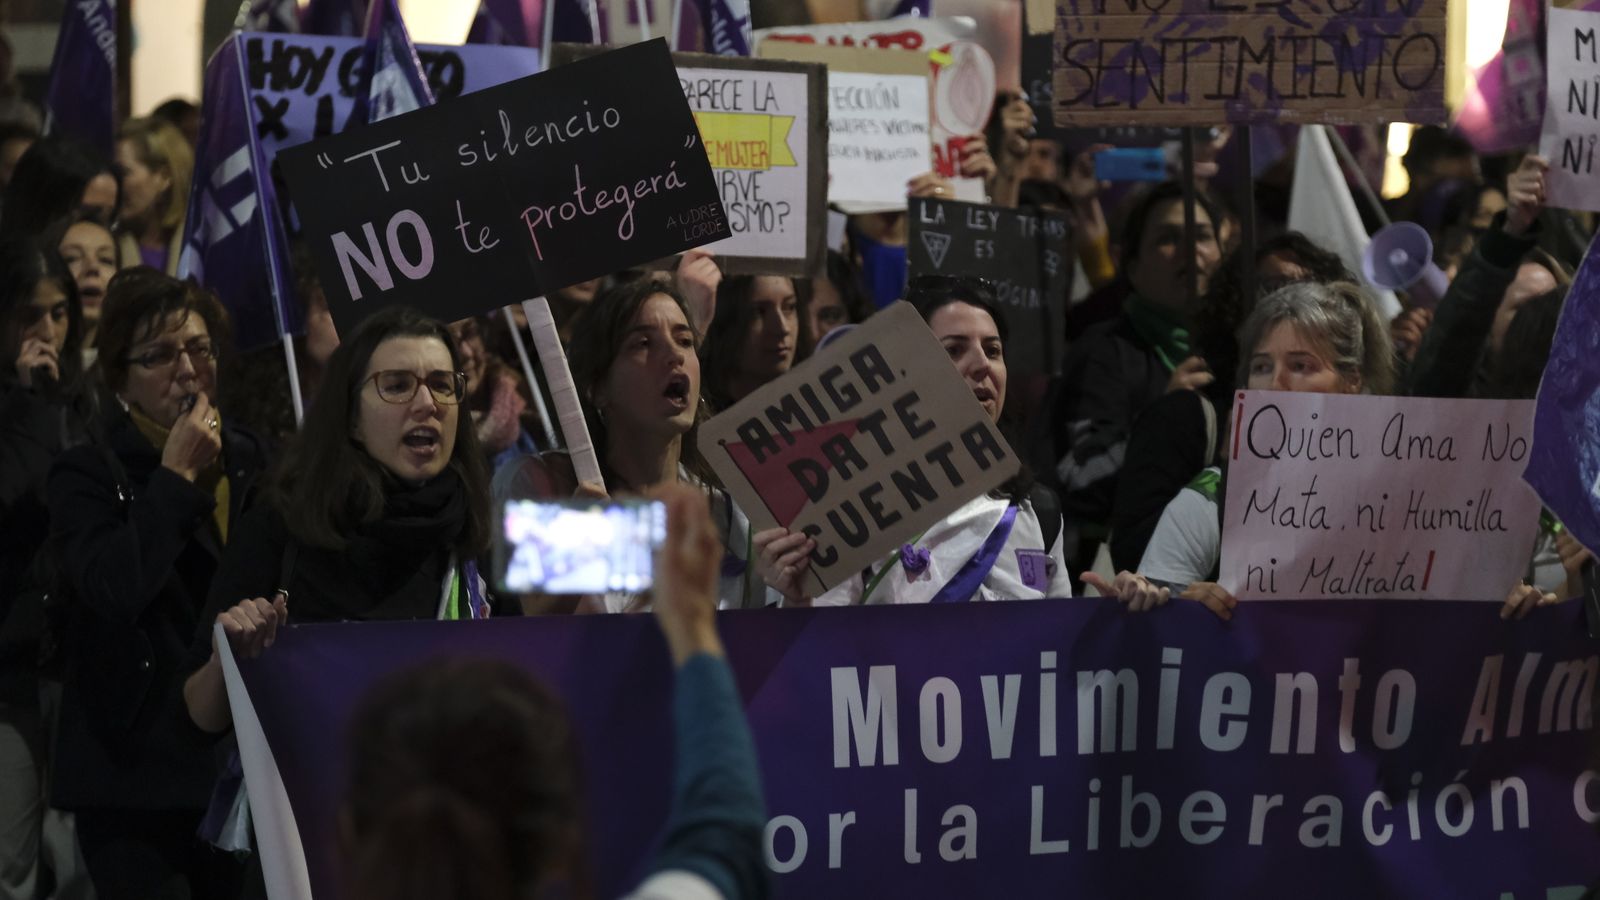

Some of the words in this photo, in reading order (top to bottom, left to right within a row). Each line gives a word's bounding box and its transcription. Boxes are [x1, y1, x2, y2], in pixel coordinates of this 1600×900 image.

[246, 37, 334, 96] HOY
[1060, 33, 1441, 108] SENTIMIENTO
[753, 80, 780, 112] LA
[458, 100, 620, 166] silencio
[716, 140, 770, 168] MUJER
[714, 170, 765, 201] IRVE
[666, 201, 720, 230] AUDRE
[684, 216, 726, 242] LORDE
[724, 201, 791, 234] ISMO?
[919, 200, 946, 224] LA
[966, 206, 1000, 232] LEY
[330, 208, 435, 301] NO
[455, 199, 500, 253] te
[974, 239, 995, 258] ES
[787, 390, 936, 504] DATE
[1233, 393, 1359, 461] ¡Quien
[1381, 413, 1457, 462] Ama
[1481, 422, 1527, 462] No
[801, 421, 1006, 568] CUENTA
[1357, 493, 1385, 533] ni
[1402, 489, 1509, 532] Humilla
[1246, 557, 1277, 594] ni
[830, 647, 1417, 768] Movimiento
[1460, 652, 1600, 746] Alm
[763, 811, 856, 874] or
[903, 788, 978, 864] la
[1029, 769, 1530, 855] Liberación
